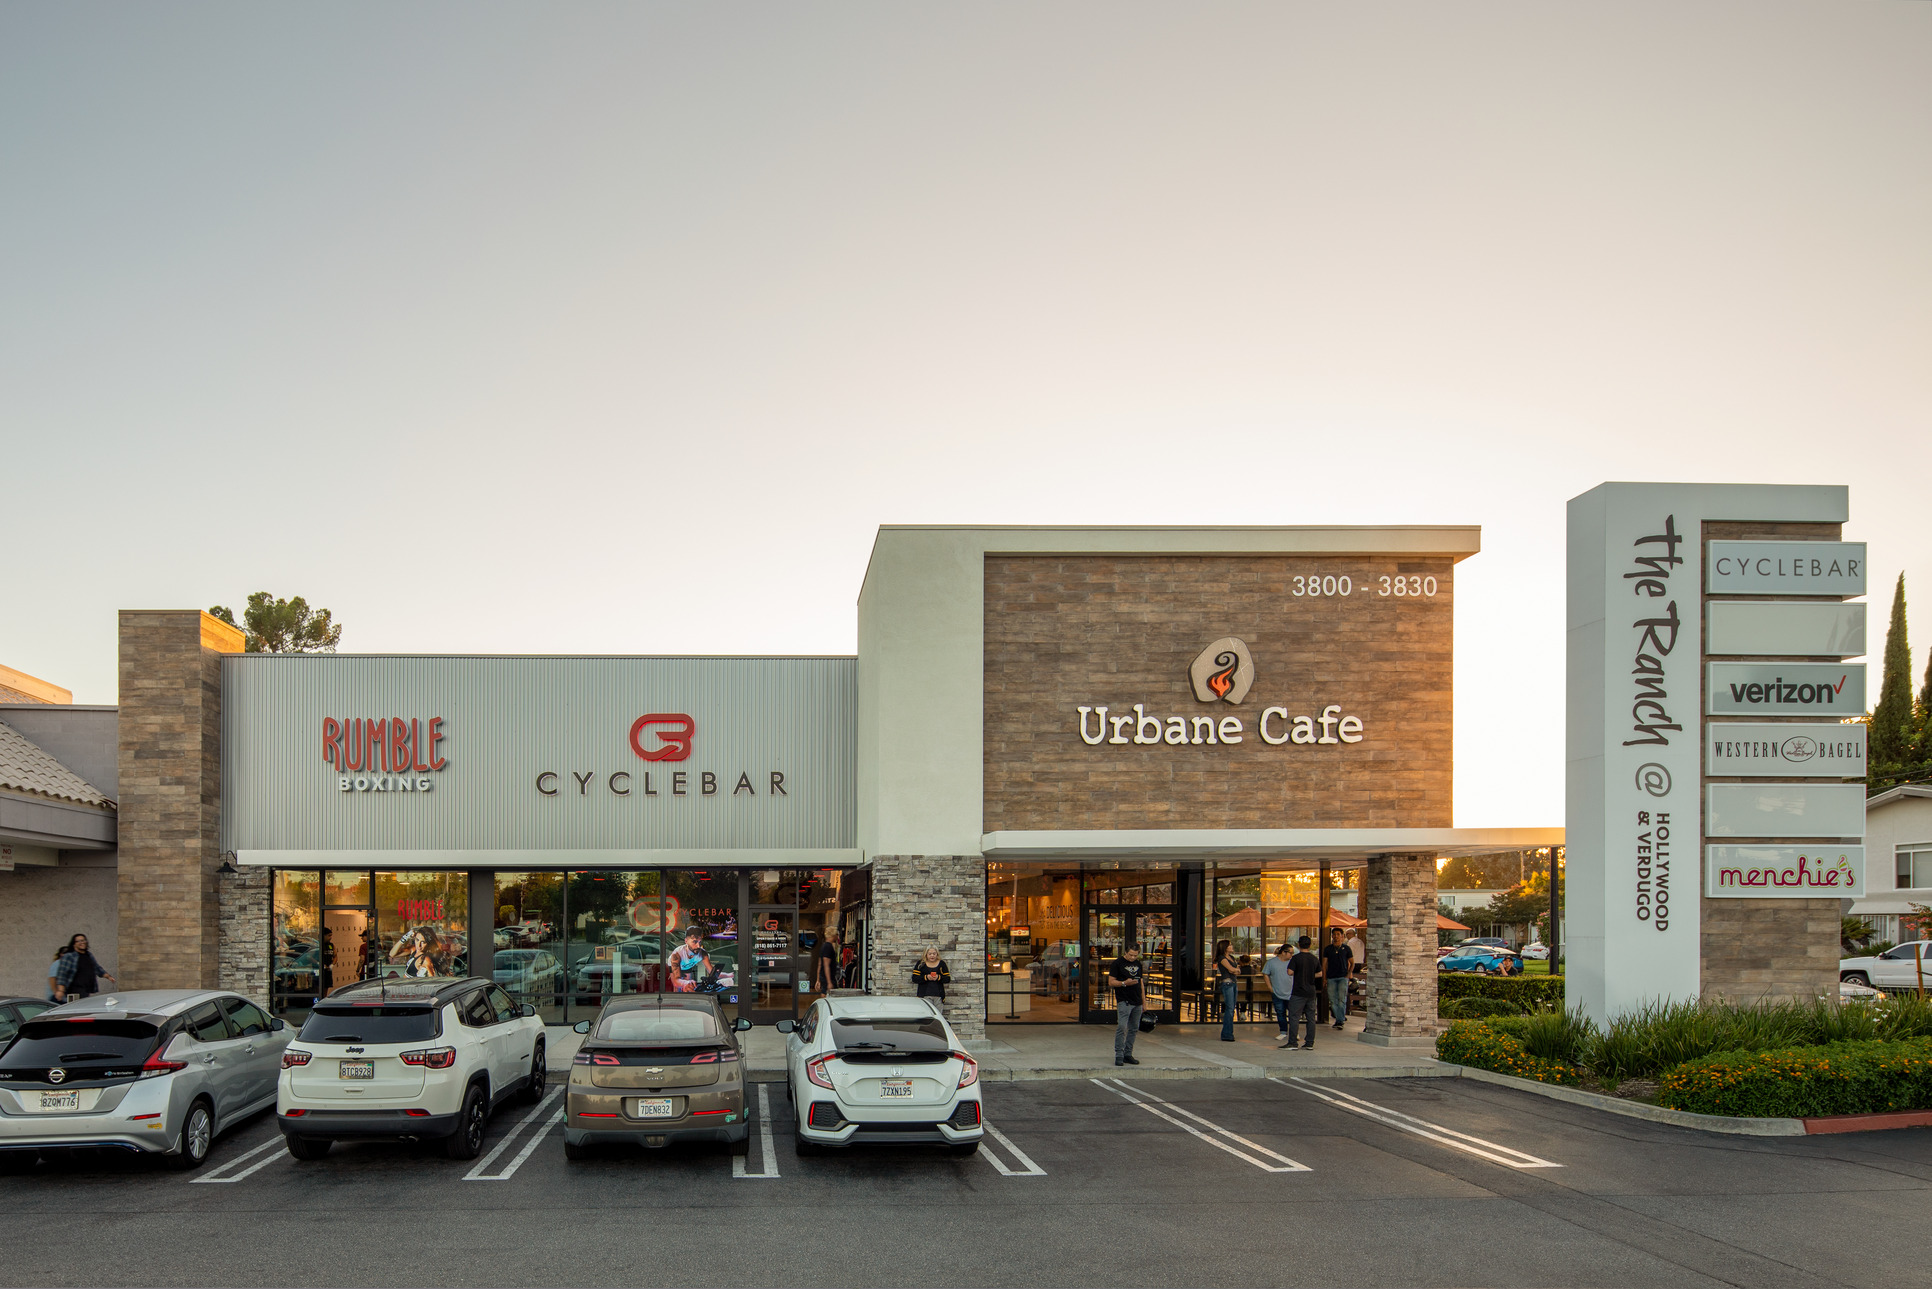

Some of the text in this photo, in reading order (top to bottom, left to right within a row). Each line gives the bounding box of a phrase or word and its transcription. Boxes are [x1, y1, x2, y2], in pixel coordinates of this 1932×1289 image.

[1716, 557, 1859, 577] CYCLEBAR
[1292, 575, 1352, 597] 3800
[1378, 575, 1438, 597] 3830
[1623, 599, 1683, 747] Ranch
[1729, 677, 1834, 704] verizon
[1077, 704, 1364, 745] Urbane Cafe
[322, 716, 447, 772] RUMBLE
[1715, 742, 1778, 758] WESTERN
[1819, 742, 1861, 758] BAGEL
[338, 776, 432, 792] BOXING
[536, 771, 788, 796] CYCLEBAR
[1635, 762, 1672, 798] @
[1636, 811, 1652, 921] & VERDUGO
[1655, 812, 1670, 932] HOLLYWOOD
[1720, 855, 1856, 887] menchie's
[397, 899, 445, 920] RUMBLE
[42, 1097, 76, 1108] 8ZQM776
[882, 1086, 912, 1097] 7ZXN195
[640, 1105, 670, 1115] 7DEN832
